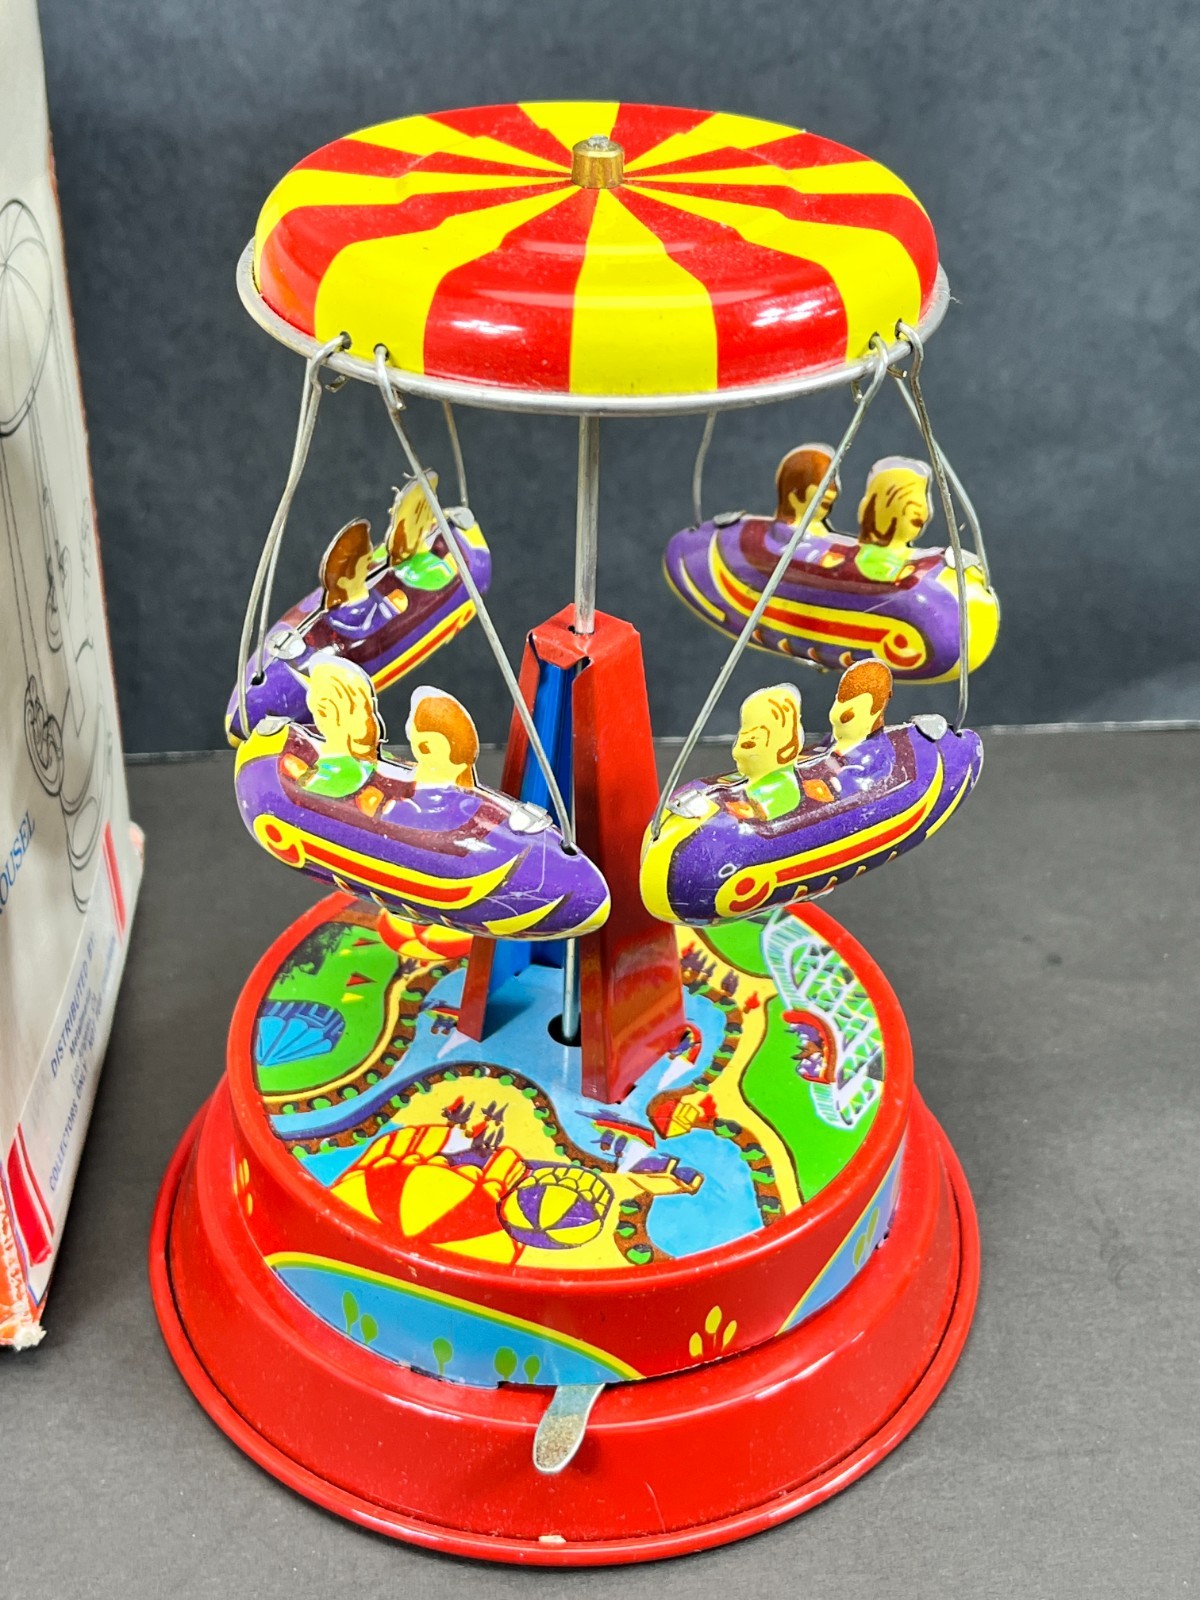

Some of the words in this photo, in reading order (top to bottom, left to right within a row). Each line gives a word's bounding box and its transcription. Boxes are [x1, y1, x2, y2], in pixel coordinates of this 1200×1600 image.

[0, 809, 36, 914] OUSEL
[50, 960, 88, 1078] DISTRIBUTED
[49, 1099, 79, 1192] COLLECTORS
